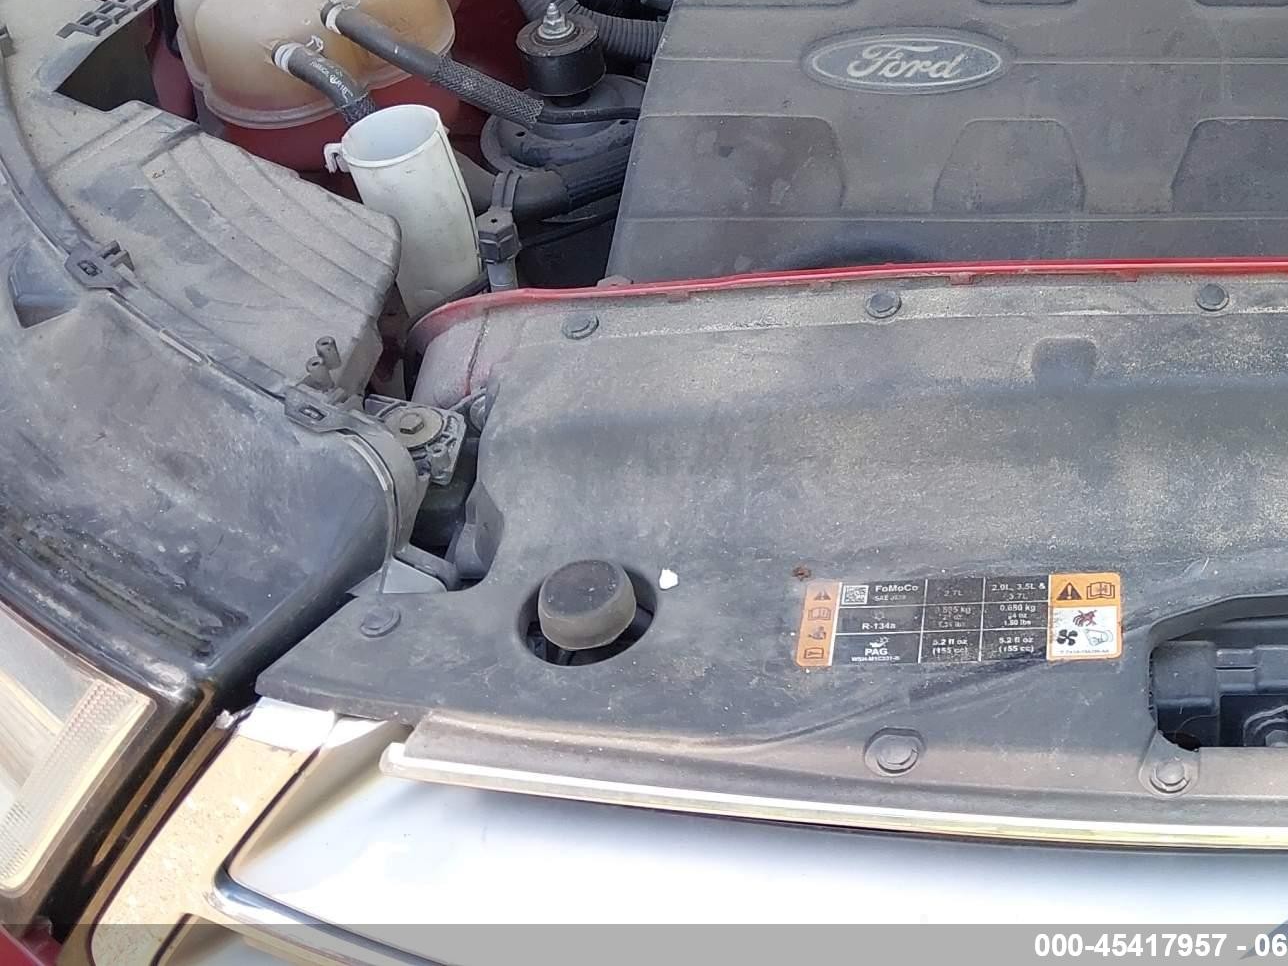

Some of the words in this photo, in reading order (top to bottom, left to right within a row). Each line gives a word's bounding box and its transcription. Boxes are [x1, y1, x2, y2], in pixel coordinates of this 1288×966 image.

[847, 44, 964, 79] Ford
[875, 584, 919, 593] FoMoCo
[1038, 582, 1046, 590] &
[1024, 604, 1036, 613] kg
[861, 622, 896, 630] R-134a
[864, 648, 888, 656] PAG
